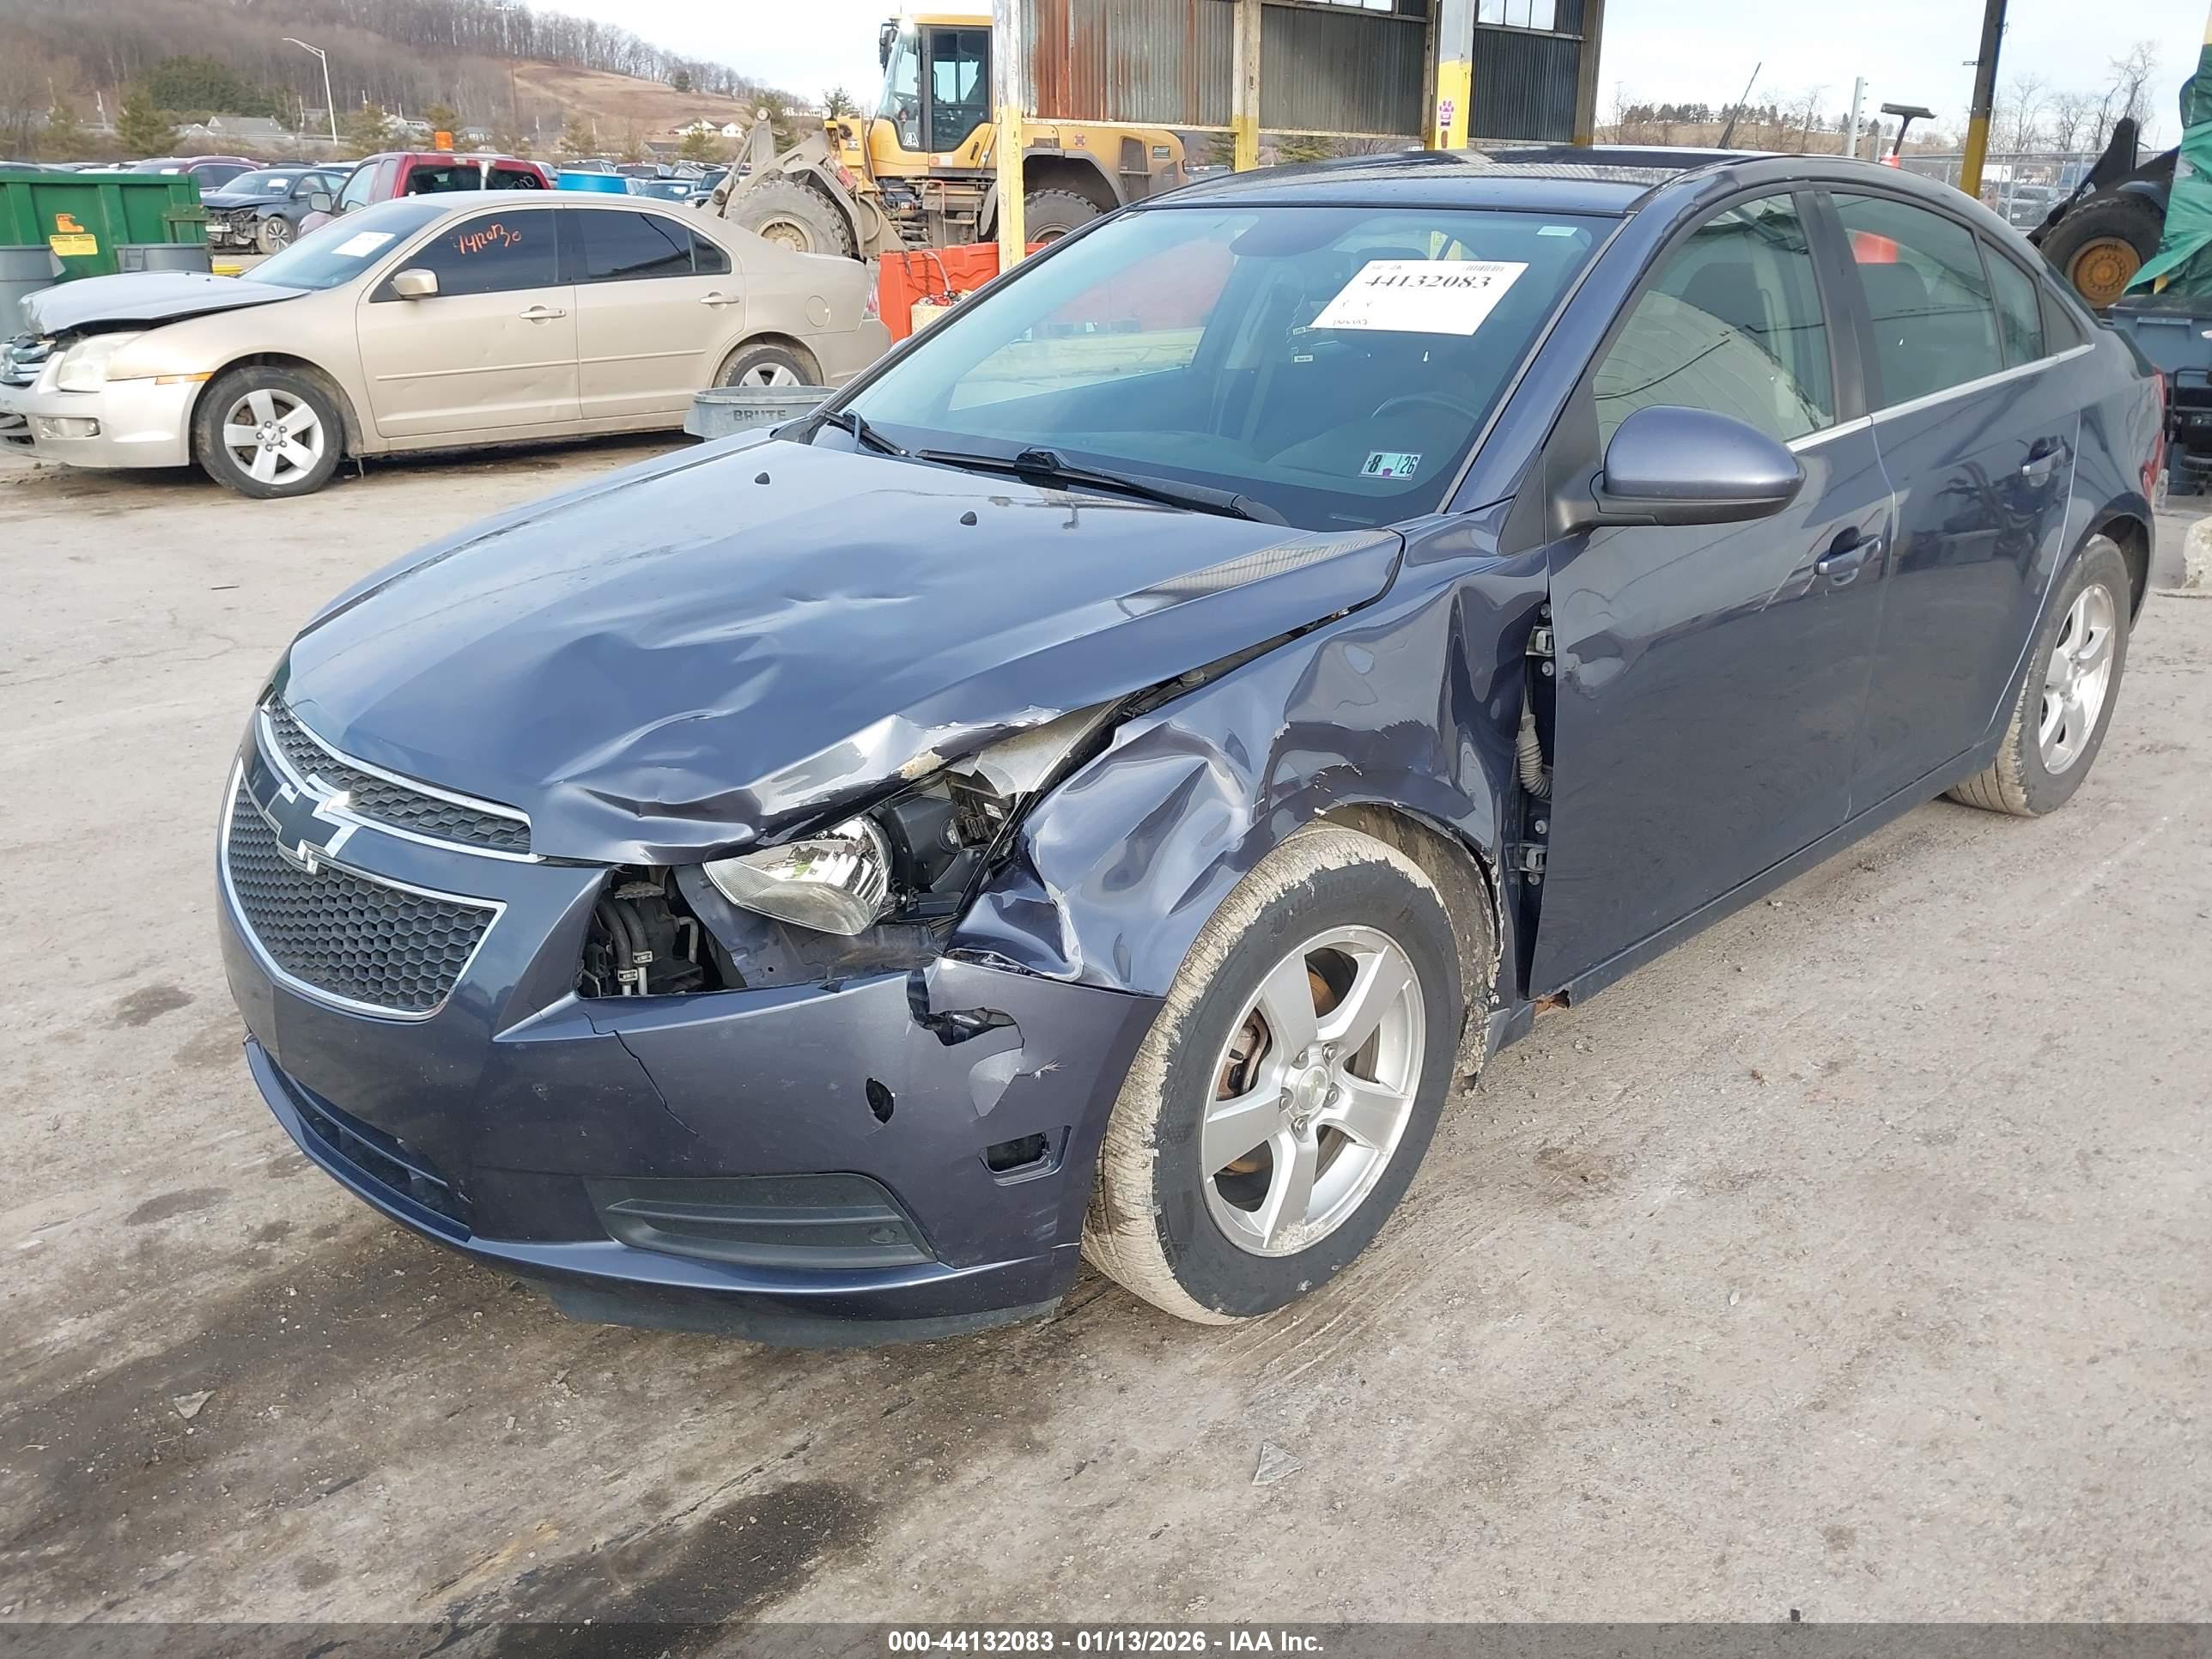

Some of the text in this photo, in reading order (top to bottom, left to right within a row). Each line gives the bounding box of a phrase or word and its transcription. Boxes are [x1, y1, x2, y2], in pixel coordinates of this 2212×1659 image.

[1364, 275, 1492, 289] 44132083
[733, 409, 787, 422] BRUTE
[1399, 455, 1419, 475] 26
